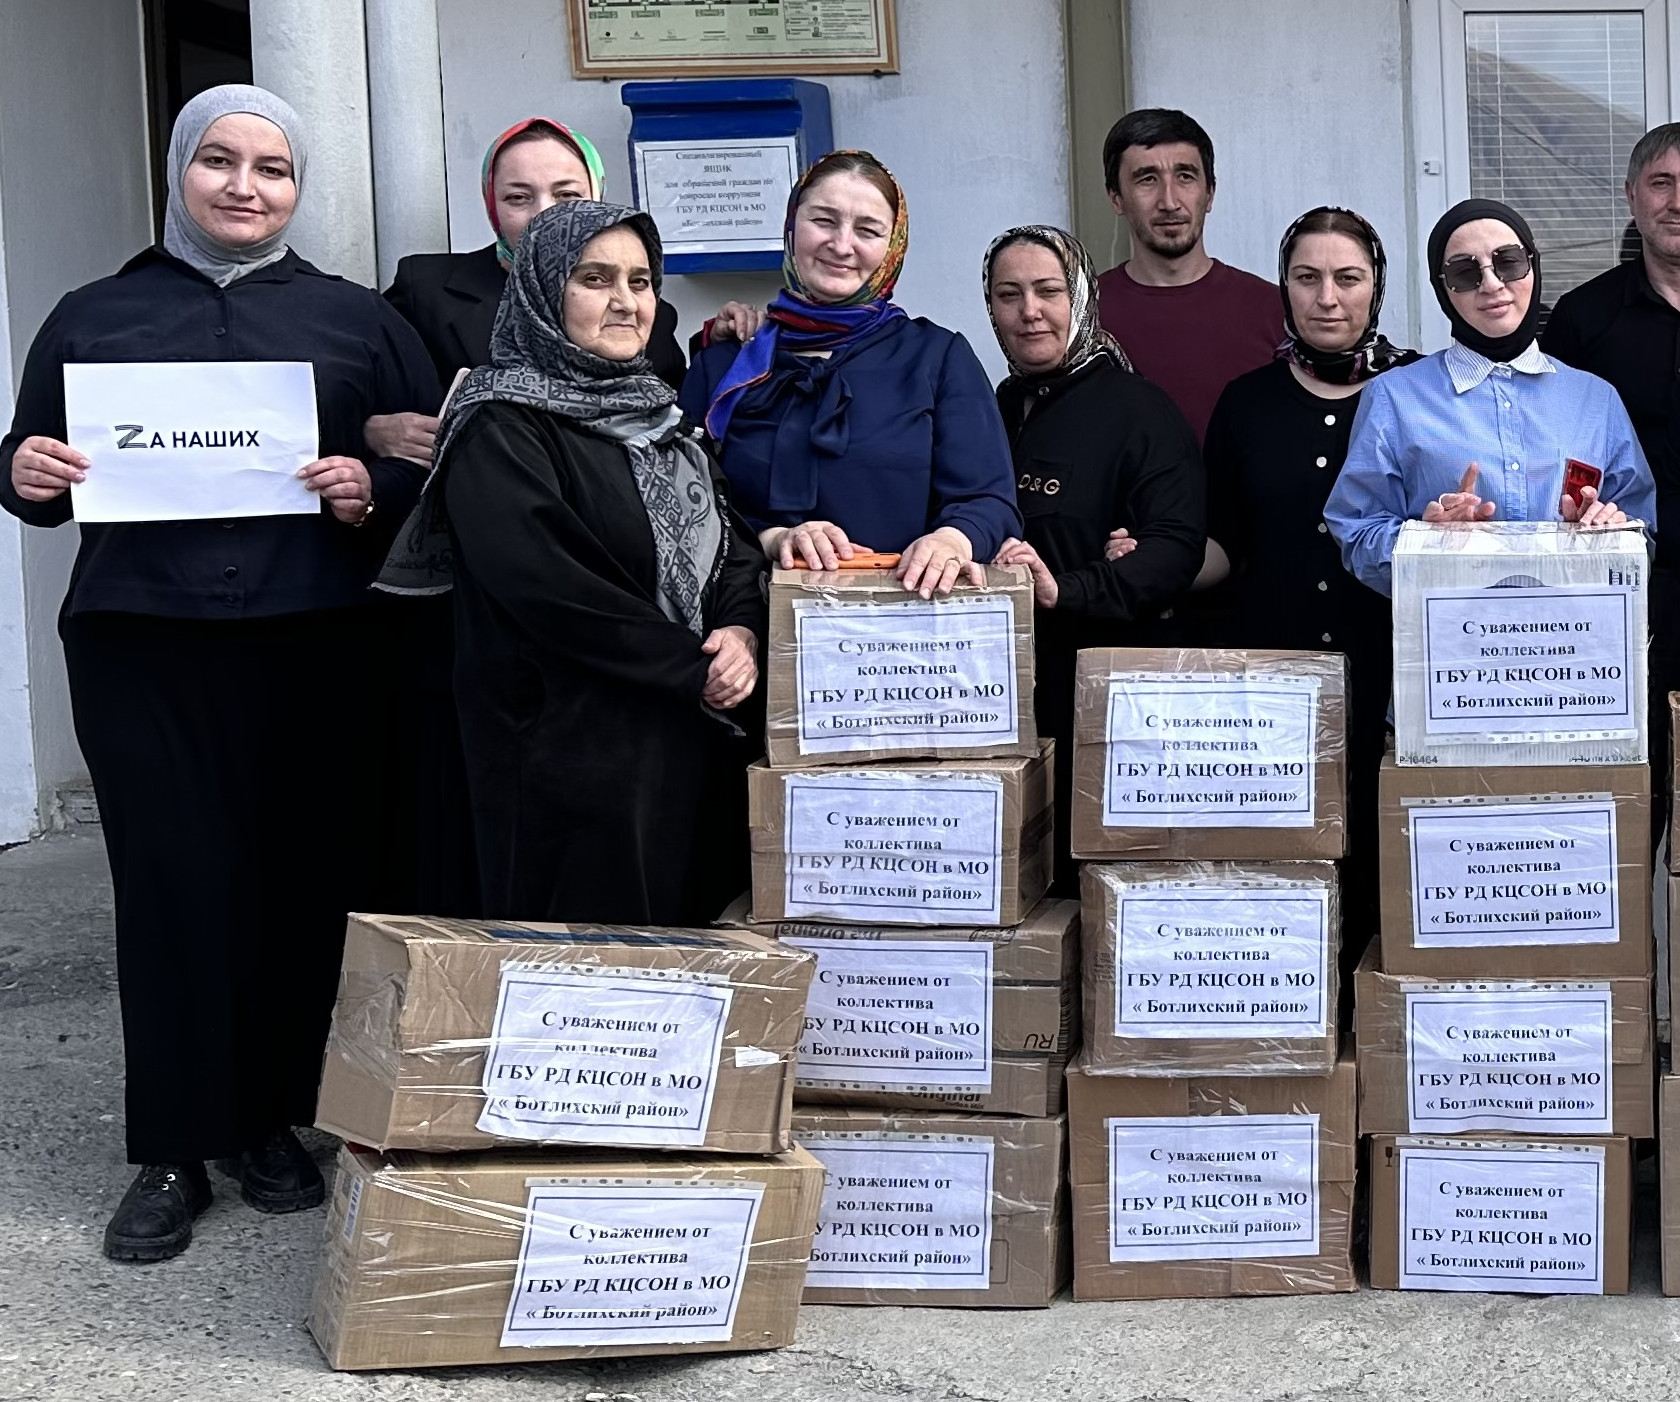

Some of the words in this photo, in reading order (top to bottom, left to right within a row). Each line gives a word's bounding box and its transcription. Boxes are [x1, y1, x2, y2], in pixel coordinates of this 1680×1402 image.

[751, 204, 766, 212] МО
[172, 430, 259, 448] НАШИХ
[1018, 474, 1060, 495] D&G
[1462, 621, 1475, 634] С
[1480, 622, 1570, 637] уважением
[1575, 622, 1592, 632] от
[1480, 645, 1575, 657] коллектива
[1435, 670, 1472, 683] ГБУ
[1476, 669, 1500, 685] РД
[1504, 667, 1571, 683] КЦСОН
[1577, 671, 1586, 680] в
[1591, 666, 1621, 679] МО
[1456, 694, 1553, 708] Ботлихский
[826, 811, 840, 825] С
[845, 816, 937, 829] уважением
[942, 815, 960, 828] от
[844, 835, 942, 851] коллектива
[799, 855, 833, 870] ГБУ
[841, 853, 865, 872] РД
[867, 854, 938, 874] КЦСОН
[943, 864, 953, 873] в
[958, 861, 989, 875] МО
[818, 881, 917, 898] Ботлихский
[1024, 1033, 1055, 1048] RU
[1150, 1149, 1162, 1161] С
[1167, 1151, 1256, 1164] уважением
[1261, 1151, 1278, 1161] от
[1168, 1173, 1262, 1183] коллектива
[1122, 1197, 1158, 1211] ГБУ
[1163, 1195, 1186, 1211] РД
[1191, 1193, 1257, 1209] КЦСОН
[1263, 1197, 1272, 1206] в
[1277, 1192, 1307, 1205] МО
[569, 1225, 583, 1239] С
[692, 1228, 711, 1238] от
[1141, 1220, 1239, 1236] Ботлихский
[526, 1279, 569, 1293] ГБУ
[573, 1279, 600, 1295] РД
[604, 1277, 678, 1294] КЦСОН
[683, 1281, 693, 1290] в
[698, 1275, 731, 1289] МО
